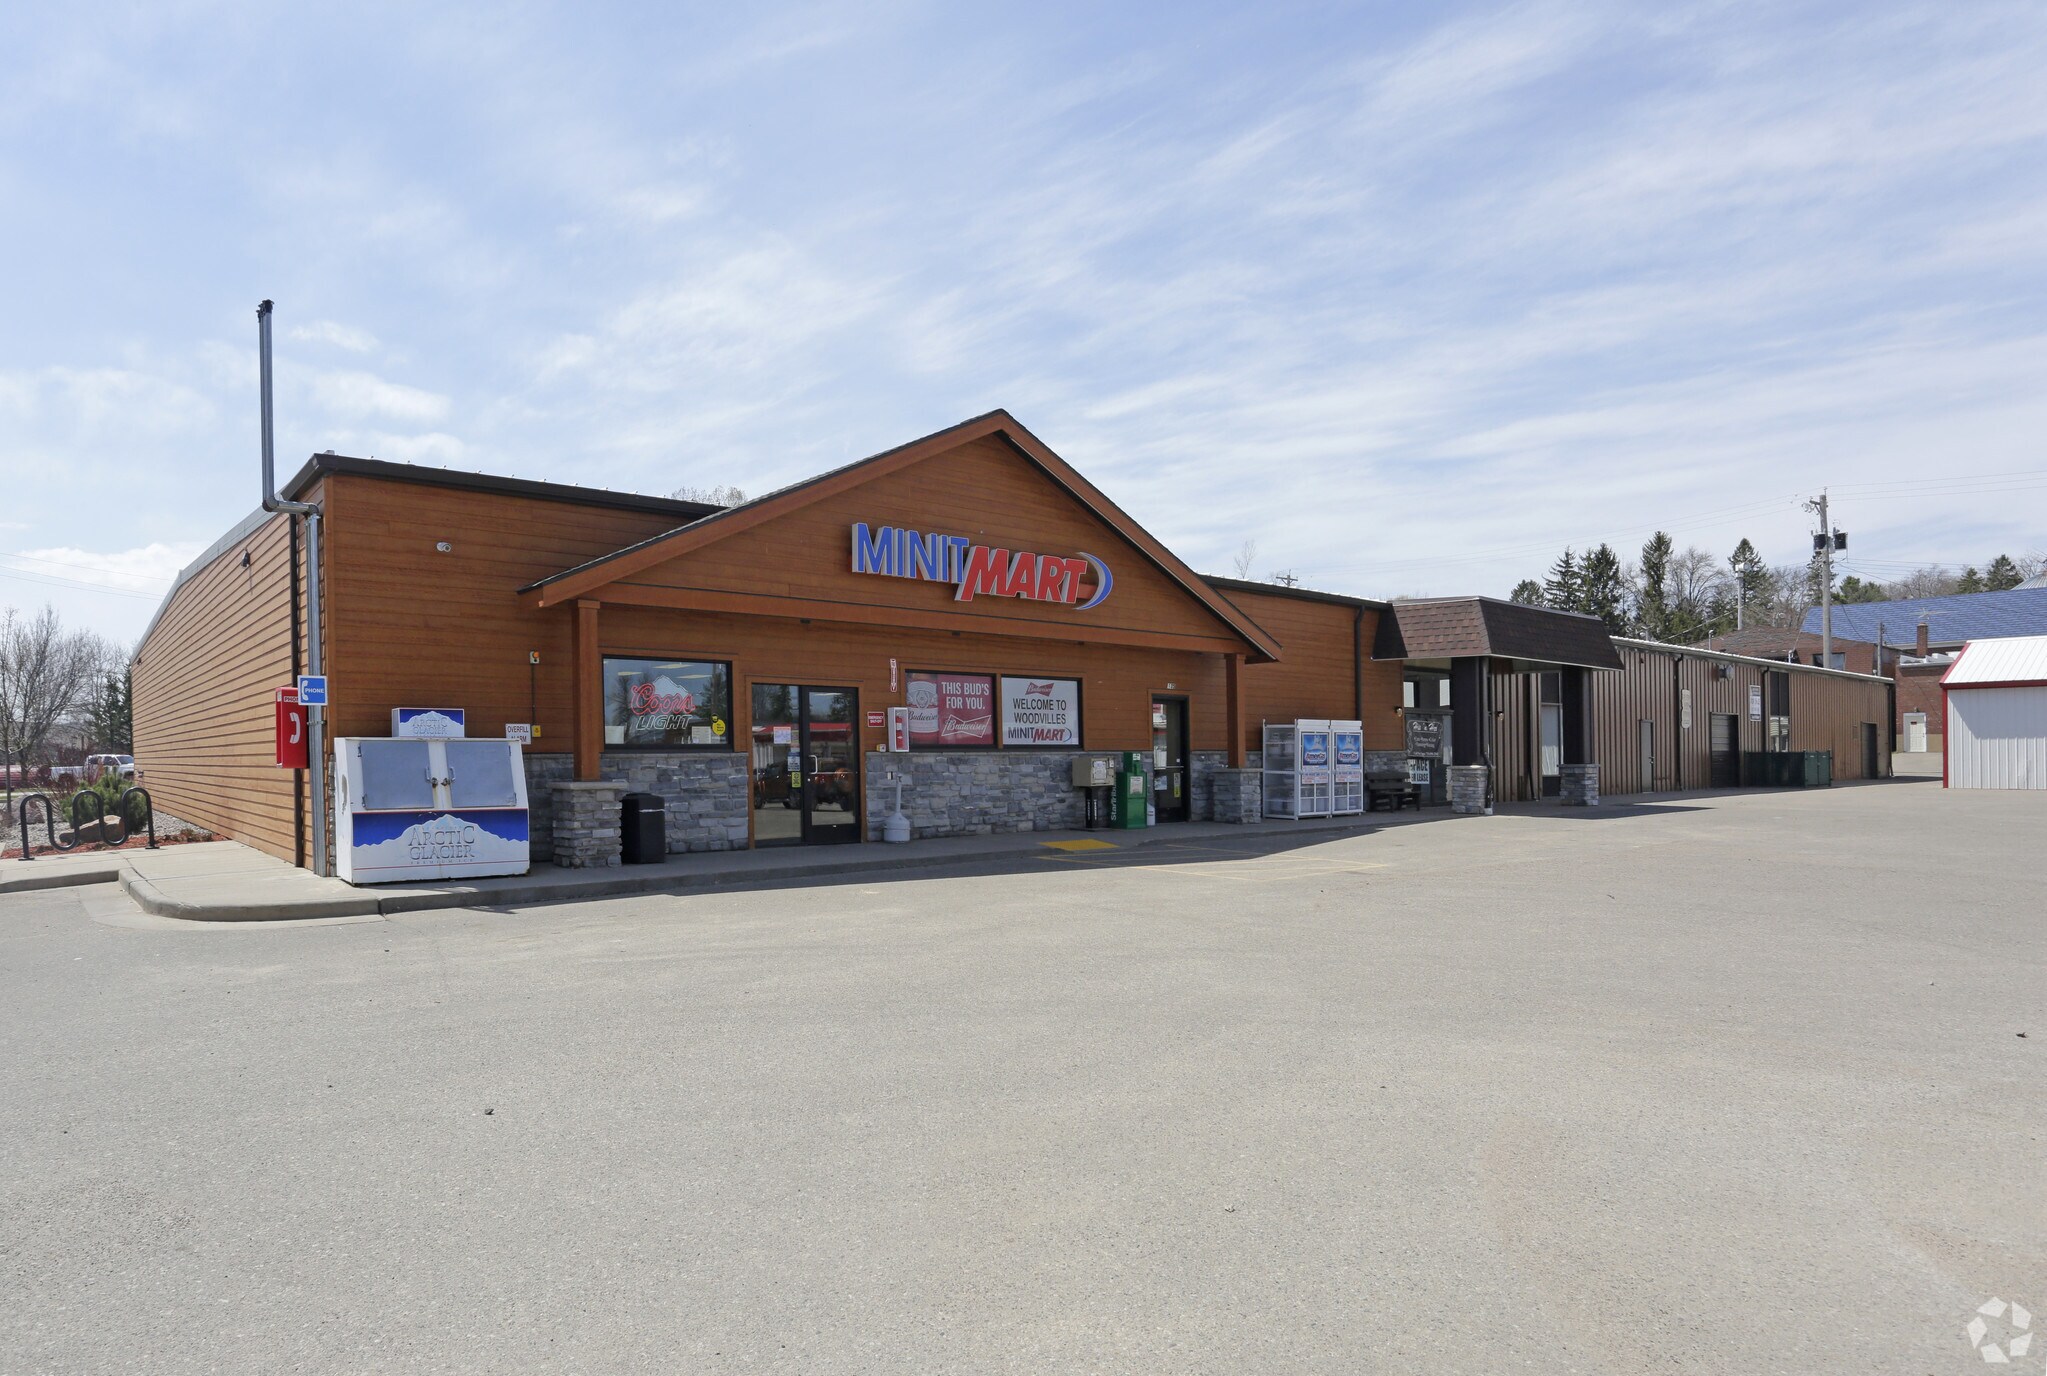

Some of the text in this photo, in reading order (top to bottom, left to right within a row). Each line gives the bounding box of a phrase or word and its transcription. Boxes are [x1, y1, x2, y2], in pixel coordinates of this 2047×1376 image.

[941, 682, 989, 696] THIS BUD'S
[630, 683, 696, 715] Coors
[946, 696, 986, 710] FOR YOU.
[1013, 698, 1066, 710] WELCOME TO
[412, 716, 448, 728] ARCTIC
[636, 714, 692, 730] LIGHT
[1014, 712, 1066, 724] WOODVILLES
[412, 727, 448, 735] GLACIER
[945, 720, 986, 731] Budweiser
[408, 826, 475, 846] ARCTIC
[410, 845, 475, 860] GLACIER
